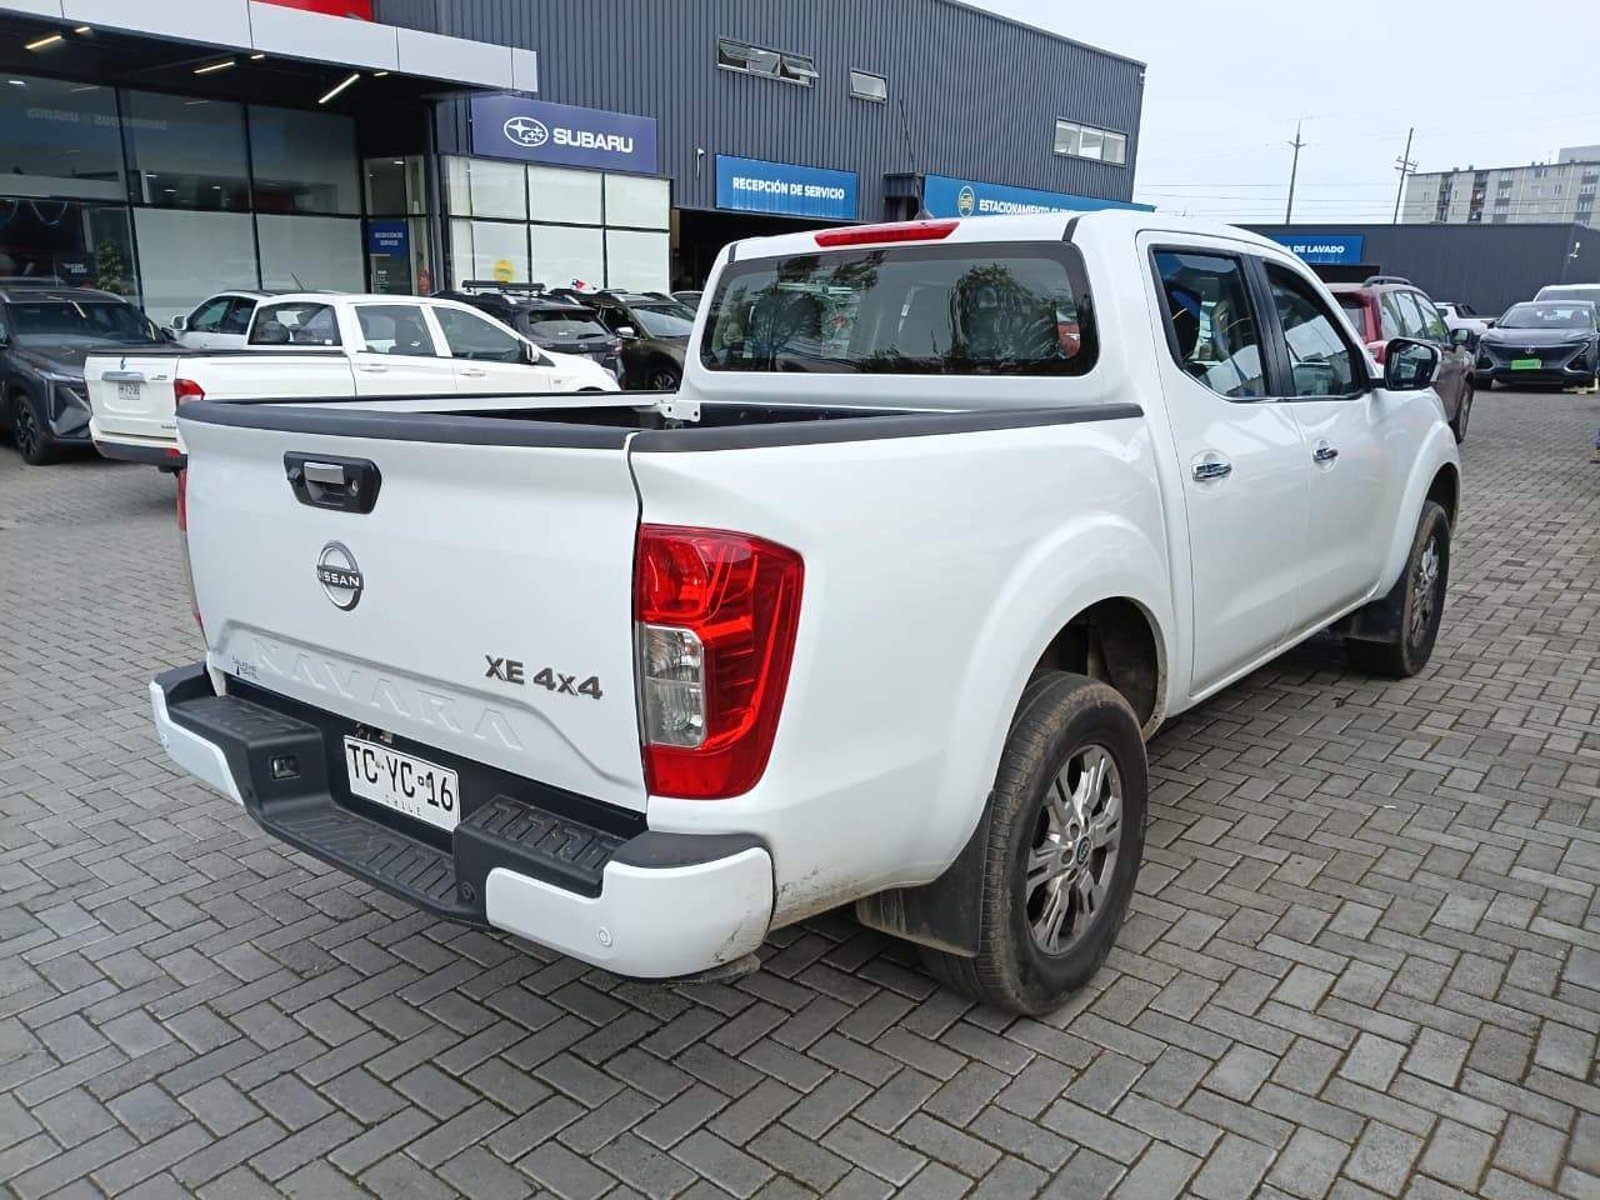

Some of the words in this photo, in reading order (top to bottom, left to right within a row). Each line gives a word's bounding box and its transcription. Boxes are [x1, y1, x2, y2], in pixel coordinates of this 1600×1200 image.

[553, 128, 633, 153] SUBARU
[732, 177, 788, 195] RECEPCIÓN
[790, 183, 803, 196] DE
[804, 185, 845, 200] SERVICIO
[1293, 245, 1306, 253] DE
[1307, 245, 1345, 254] LAVADO
[318, 569, 360, 587] ISSAN
[485, 654, 525, 685] XE
[251, 638, 522, 750] NAVARA
